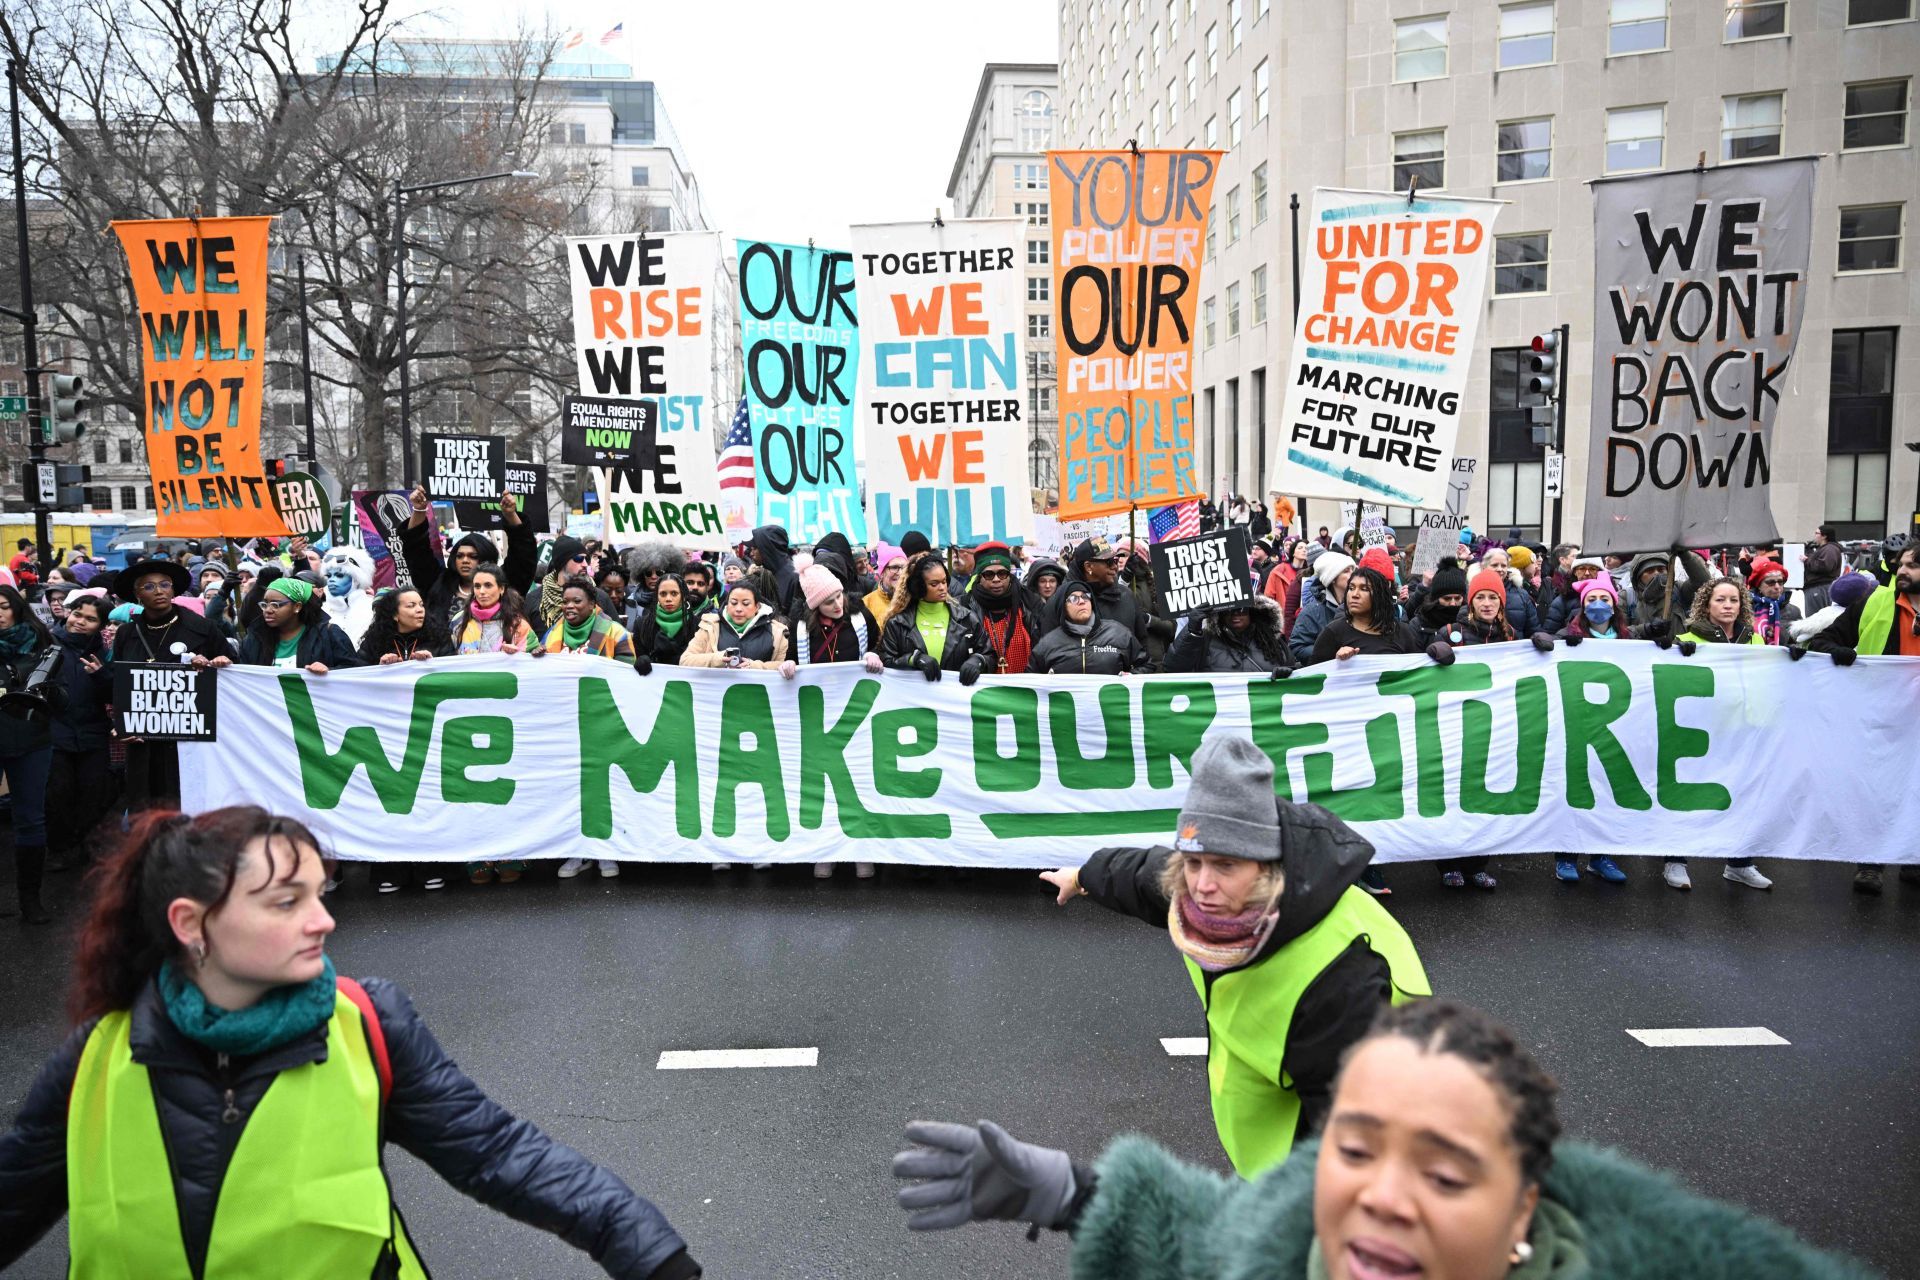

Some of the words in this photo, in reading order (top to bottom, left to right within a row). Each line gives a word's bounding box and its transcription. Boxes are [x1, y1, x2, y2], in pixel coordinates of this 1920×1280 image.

[1054, 152, 1213, 230] YOUR
[1061, 227, 1199, 267] POWER
[1316, 218, 1484, 261] UNITED
[1633, 198, 1767, 273] WE
[146, 236, 239, 294] WE
[578, 239, 666, 287] WE
[862, 247, 1014, 276] TOGETHER
[740, 243, 858, 328] OUR
[1322, 260, 1459, 317] FOR
[589, 287, 701, 340] RISE
[890, 282, 989, 336] WE
[1062, 264, 1190, 356] OUR
[1609, 271, 1799, 346] WONT
[144, 309, 255, 362] WILL
[1303, 314, 1459, 356] CHANGE
[585, 346, 666, 395] WE
[748, 339, 850, 409] OUR
[873, 333, 1017, 390] CAN
[1067, 351, 1188, 393] POWER
[151, 378, 244, 433] NOT
[1297, 363, 1459, 416] MARCHING
[1612, 350, 1790, 435] BACK
[571, 403, 605, 417] EQUAL
[607, 405, 646, 419] RIGHTS
[571, 415, 645, 431] AMENDMENT
[871, 399, 1021, 425] TOGETHER
[1065, 395, 1190, 459] PEOPLE
[1301, 397, 1358, 425] FOR
[1370, 412, 1436, 445] OUR
[176, 433, 224, 475] BE
[434, 439, 490, 459] TRUST
[585, 429, 632, 449] NOW
[760, 424, 845, 495] OUR
[897, 430, 985, 483] WE
[1290, 422, 1442, 473] FUTURE
[40, 468, 53, 477] ONE
[41, 479, 53, 488] WAY
[434, 458, 490, 478] BLACK
[1066, 451, 1198, 505] POWER
[1548, 470, 1559, 479] WAY
[1549, 457, 1559, 468] ONE
[1605, 431, 1771, 499] DOWN
[160, 476, 264, 515] SILENT
[276, 479, 320, 510] ERA
[429, 476, 501, 498] WOMEN.
[281, 508, 324, 534] NOW
[610, 501, 723, 535] MARCH
[762, 489, 858, 545] FIGHT
[874, 486, 1024, 547] WILL
[1063, 531, 1090, 540] FASCISTS
[1164, 537, 1227, 568] TRUST
[1363, 535, 1386, 546] POWER
[1168, 559, 1233, 590] BLACK
[1164, 579, 1249, 613] WOMEN.
[1093, 645, 1118, 653] FreeHer
[130, 669, 198, 691] TRUST
[131, 691, 198, 713] BLACK
[123, 712, 211, 735] WOMEN.
[970, 680, 1217, 793] OUR
[1247, 660, 1732, 822] FUTURE
